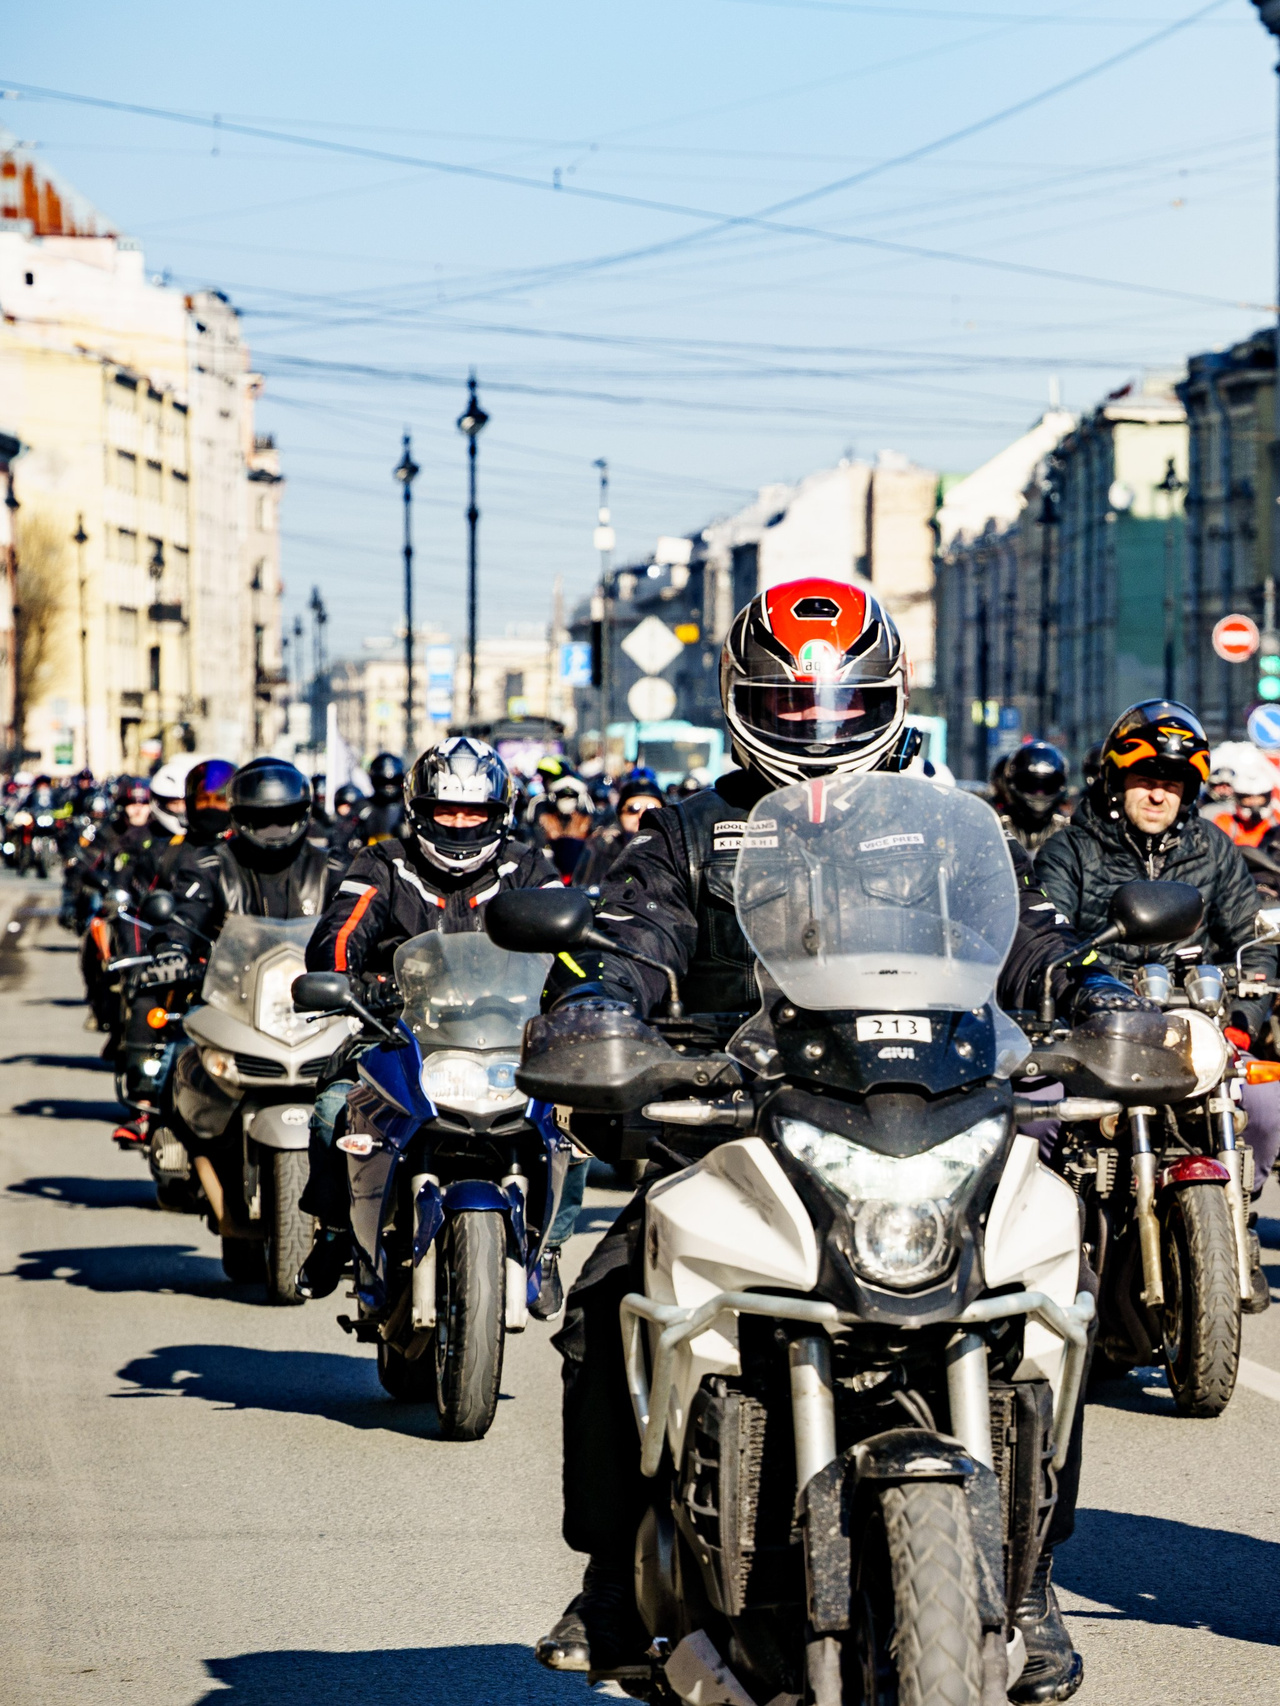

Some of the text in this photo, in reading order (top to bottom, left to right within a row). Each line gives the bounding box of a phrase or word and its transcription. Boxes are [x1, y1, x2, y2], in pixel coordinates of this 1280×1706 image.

[718, 839, 774, 848] KIRSHI
[863, 834, 920, 849] VICE PRES
[870, 1019, 918, 1035] 213
